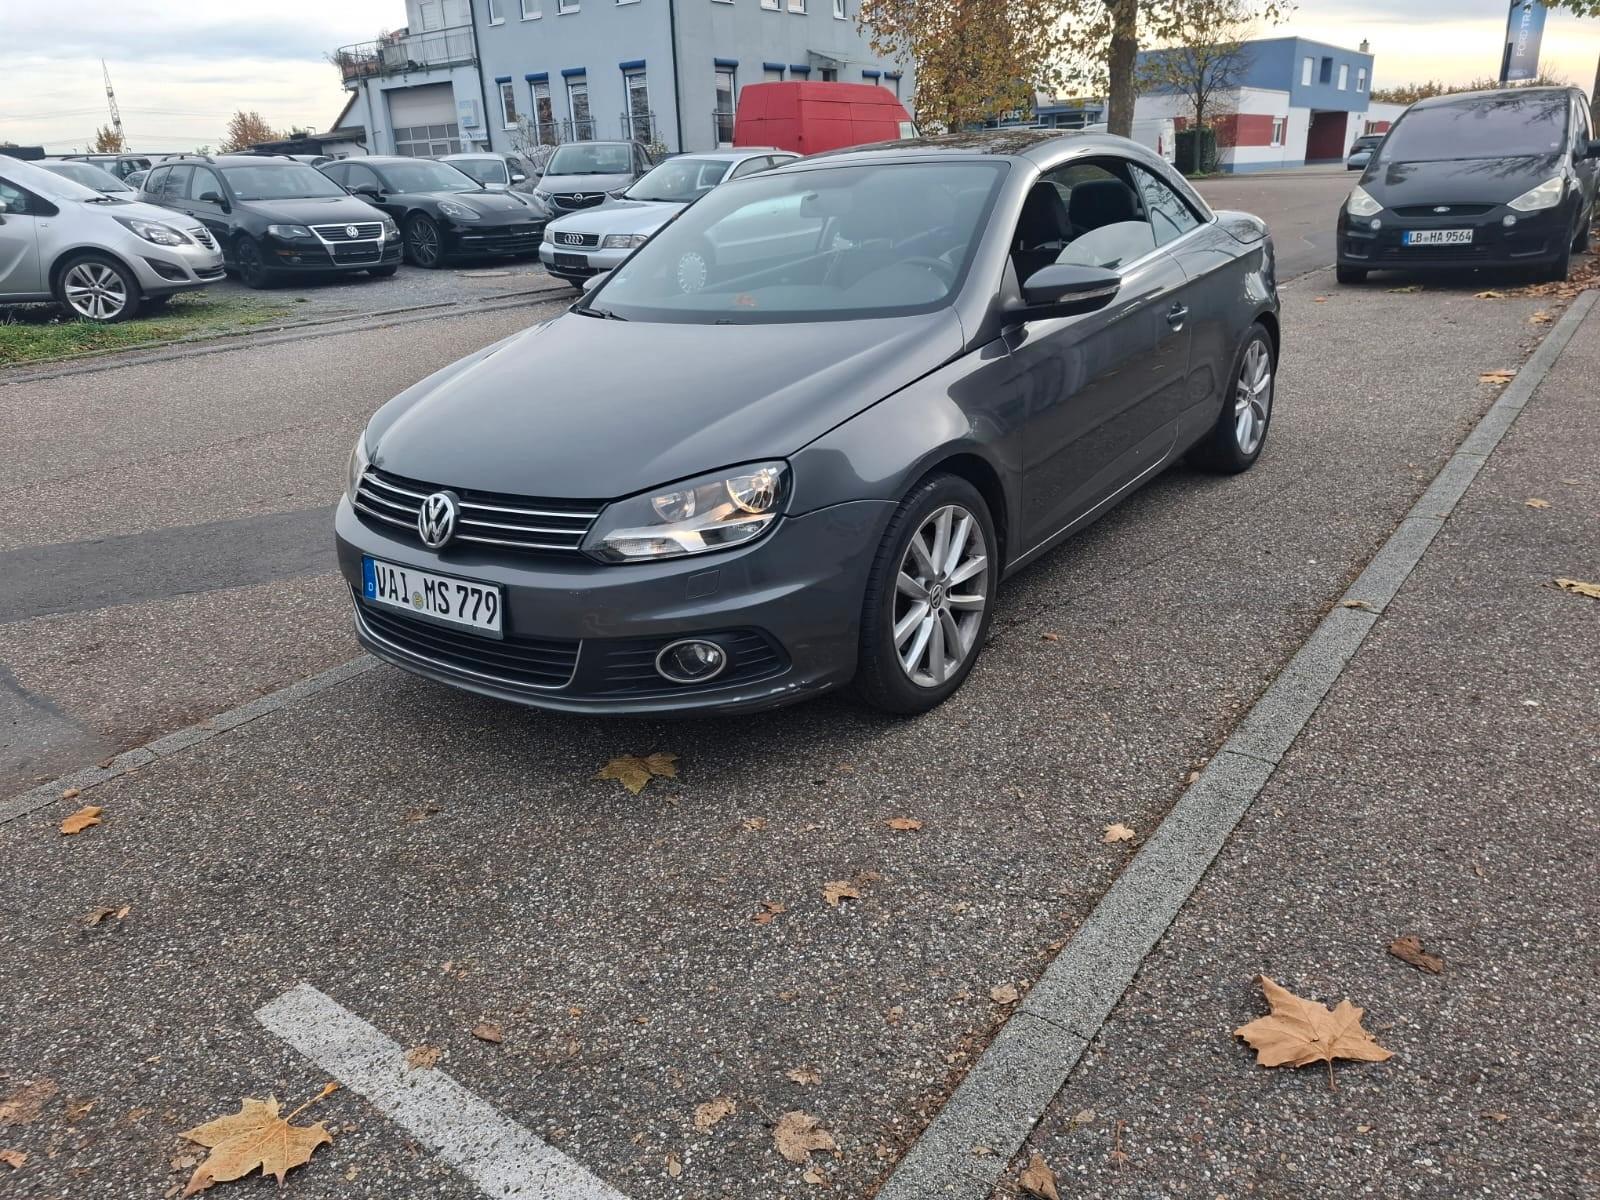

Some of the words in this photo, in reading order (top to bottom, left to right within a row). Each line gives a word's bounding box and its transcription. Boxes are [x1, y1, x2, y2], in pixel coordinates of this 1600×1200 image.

[1409, 232, 1422, 243] LB
[1430, 231, 1443, 242] HA
[1446, 231, 1472, 242] 9564
[418, 493, 454, 548] VW
[368, 582, 374, 592] D
[375, 565, 410, 604] VAI
[423, 577, 450, 615] MS
[456, 584, 498, 625] 779
